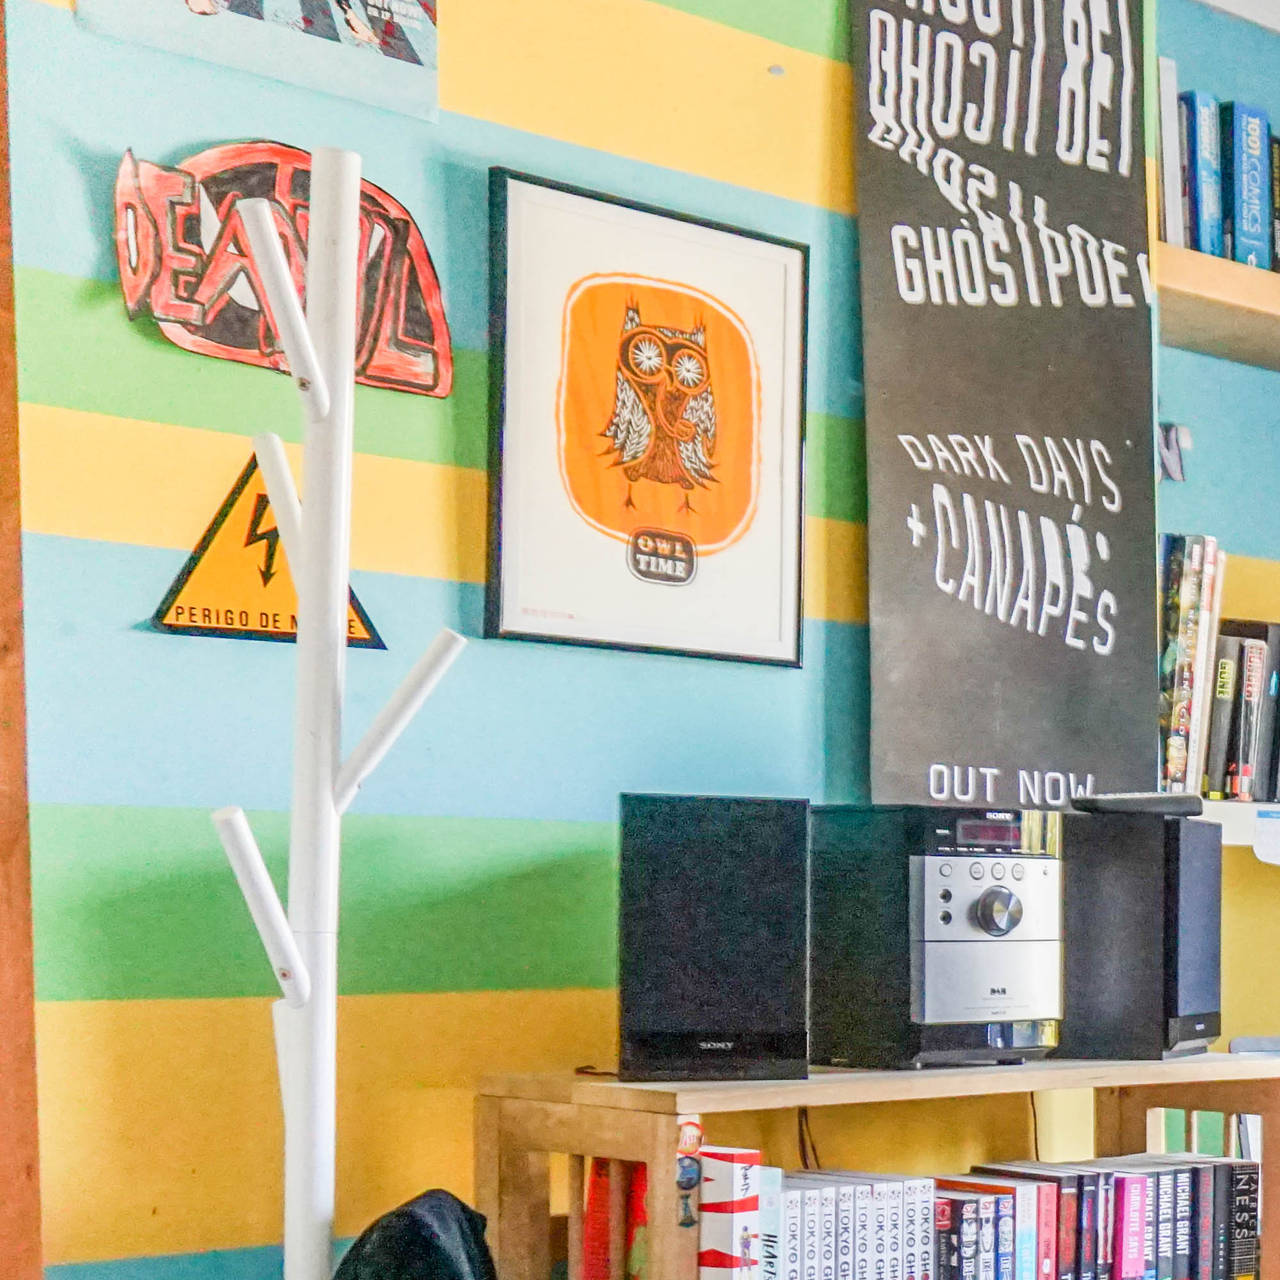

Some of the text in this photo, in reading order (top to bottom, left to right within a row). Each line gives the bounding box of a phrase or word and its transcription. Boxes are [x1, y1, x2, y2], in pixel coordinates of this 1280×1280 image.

[1247, 116, 1261, 233] 1001 COMICS
[897, 434, 1123, 514] DARK DAYS
[636, 553, 687, 579] TIME
[637, 535, 688, 558] OWL
[175, 605, 249, 627] PERIGO
[259, 612, 281, 629] DE
[1217, 660, 1233, 698] GONE
[929, 764, 1096, 806] OUT NOW
[986, 812, 1014, 820] SONY
[698, 1041, 734, 1050] SONY
[1129, 1183, 1141, 1233] CHARLOTTE
[1144, 1177, 1154, 1225] MICHAEL
[1158, 1174, 1173, 1221] MICHAEL
[1176, 1172, 1190, 1218] MICHAEL
[1235, 1174, 1250, 1239] NESS
[1248, 1172, 1258, 1237] PATRICK
[788, 1215, 798, 1263] TOKYO
[806, 1209, 816, 1257] TOKYO
[823, 1213, 832, 1260] TOKYO
[840, 1208, 850, 1257] TOKYO
[858, 1206, 867, 1254] TOKYO
[875, 1206, 885, 1254] TOKYO
[890, 1204, 899, 1253] TOKYO
[905, 1201, 916, 1248] TOKYO
[920, 1199, 931, 1246] TOKYO
[1143, 1227, 1154, 1261] GRANT
[1157, 1222, 1172, 1258] GRANT
[1175, 1220, 1189, 1256] GRANT
